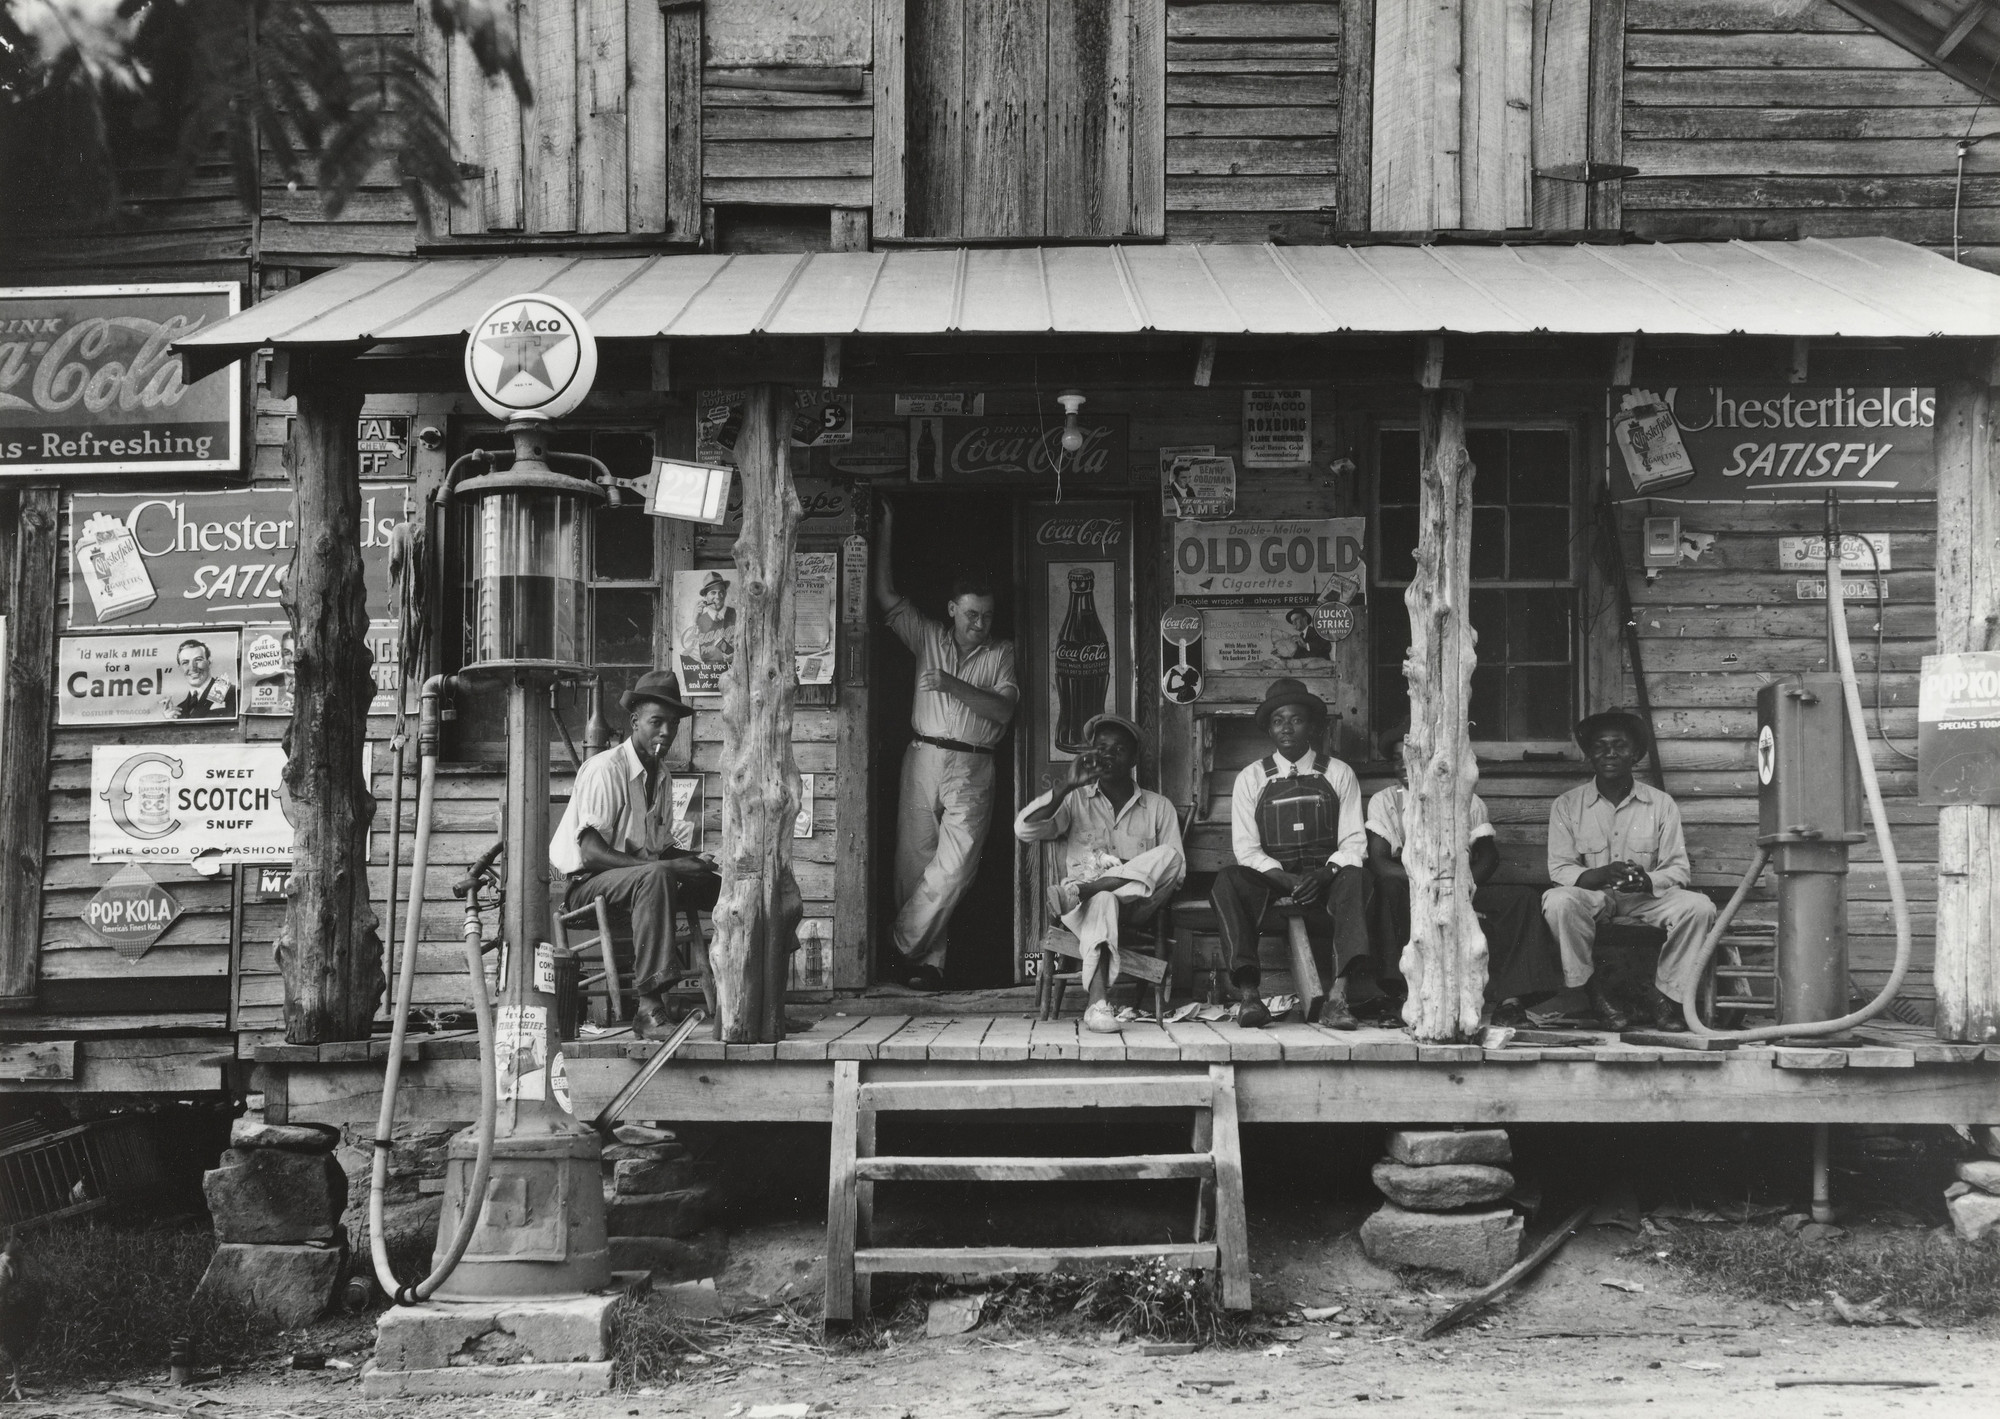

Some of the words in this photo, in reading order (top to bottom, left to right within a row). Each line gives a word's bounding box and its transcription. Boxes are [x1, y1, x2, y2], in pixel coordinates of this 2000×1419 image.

[0, 318, 62, 333] INK
[489, 319, 561, 335] TEXACO
[702, 390, 748, 407] ADVERTIS
[1252, 391, 1275, 399] SELL
[1277, 391, 1301, 399] YOUR
[1248, 401, 1306, 411] TOBACCO
[357, 420, 401, 439] TAL
[1247, 418, 1306, 432] ROXBORO
[360, 442, 388, 451] CHEW
[1722, 443, 1894, 478] SATISFY
[1199, 466, 1226, 475] BENNY
[1193, 475, 1232, 484] GOODMAN
[1184, 504, 1229, 515] AMEL
[1036, 518, 1124, 545] Coca-Cola
[1178, 536, 1252, 575] OLD
[1259, 535, 1361, 575] GOLD
[183, 564, 288, 600] SATIS
[1221, 577, 1293, 592] Cigarettes
[1318, 609, 1348, 619] LUCKY
[1163, 617, 1199, 630] Coca-Cola
[1317, 620, 1350, 628] STRIKE
[95, 649, 118, 659] walk
[131, 648, 159, 658] MILE
[250, 650, 280, 660] PRINCELY
[1057, 642, 1108, 662] Coca-Cola
[105, 662, 119, 672] for
[124, 664, 130, 672] a
[252, 657, 281, 669] SMOKIN'
[683, 661, 700, 671] keeps
[701, 661, 712, 669] the
[698, 671, 709, 679] the
[258, 687, 273, 696] 50
[1927, 671, 1969, 701] POP
[1937, 721, 1977, 731] SPECIALS
[206, 768, 254, 779] SWEET
[178, 787, 269, 811] SCOTCH
[206, 819, 254, 829] SNUFF
[111, 847, 133, 855] THE
[141, 847, 179, 855] GOOD
[225, 846, 294, 855] FASHIONE
[90, 900, 123, 925] POP
[125, 897, 172, 923] KOLA
[102, 924, 129, 933] America's
[129, 923, 147, 932] Finest
[147, 922, 161, 931] Kola
